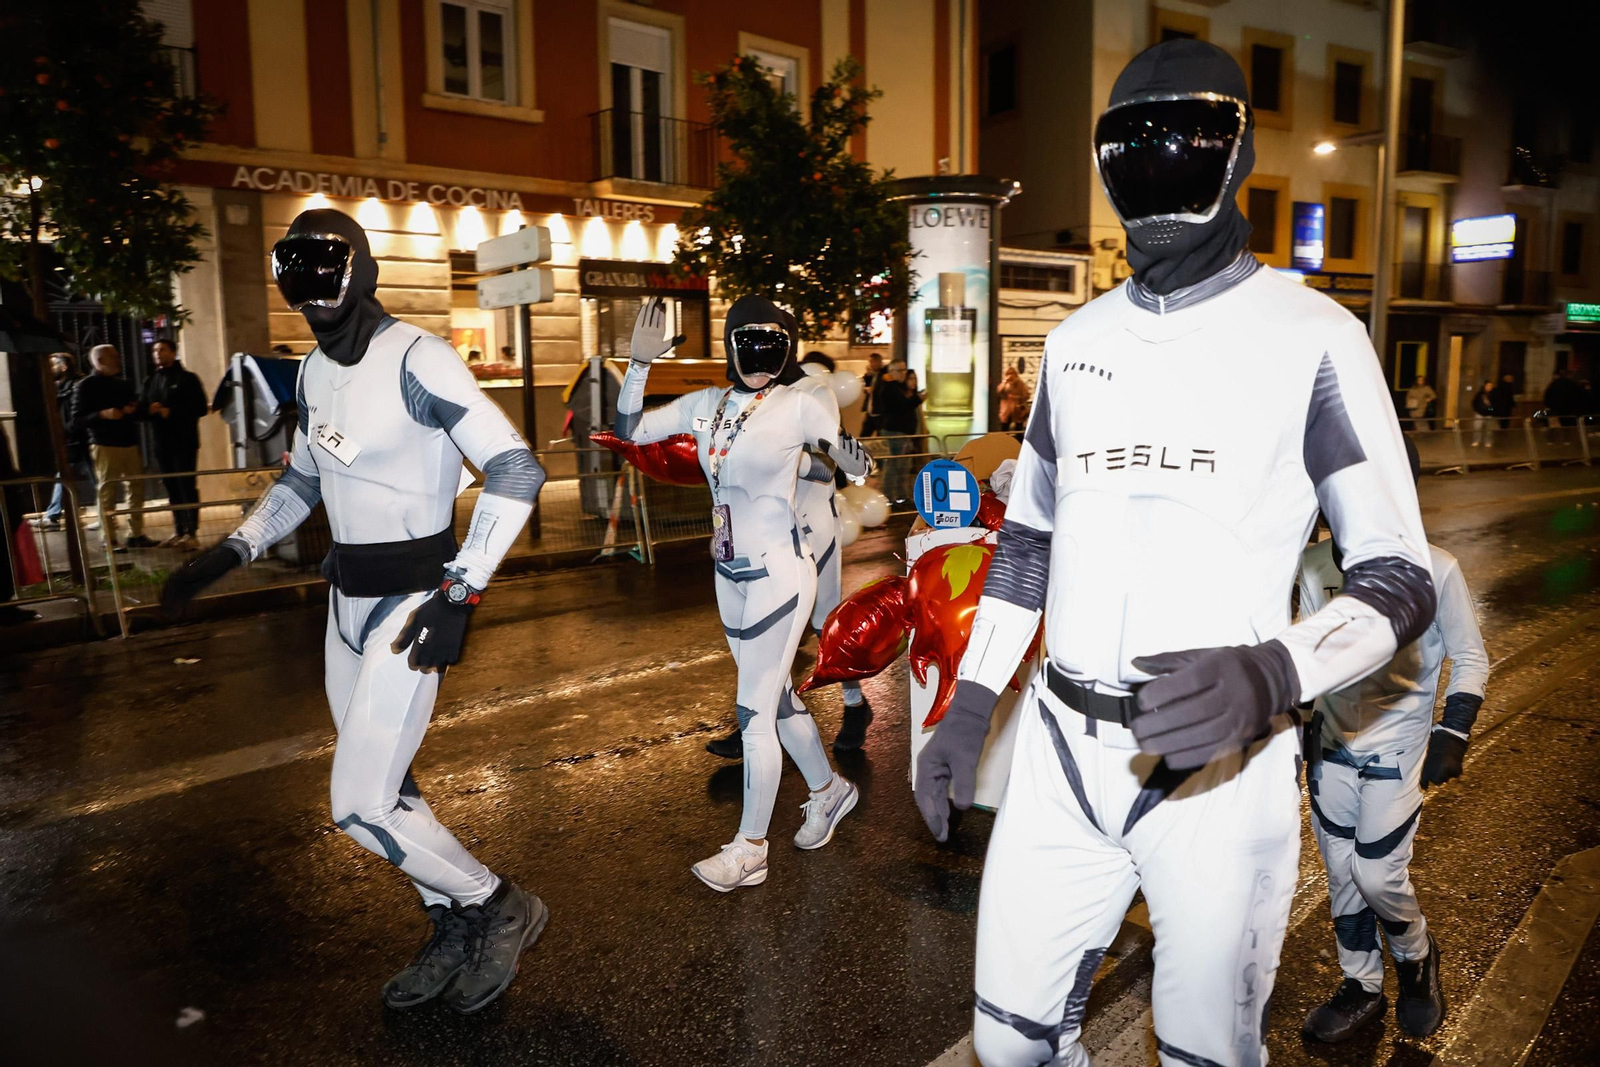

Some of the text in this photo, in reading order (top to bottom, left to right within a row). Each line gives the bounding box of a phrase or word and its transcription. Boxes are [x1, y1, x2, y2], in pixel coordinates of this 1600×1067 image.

[231, 166, 524, 212] ACADEMIA DE COCINA
[573, 198, 655, 223] TALLERES
[912, 207, 989, 229] LOEWE
[1077, 445, 1215, 474] TESLA
